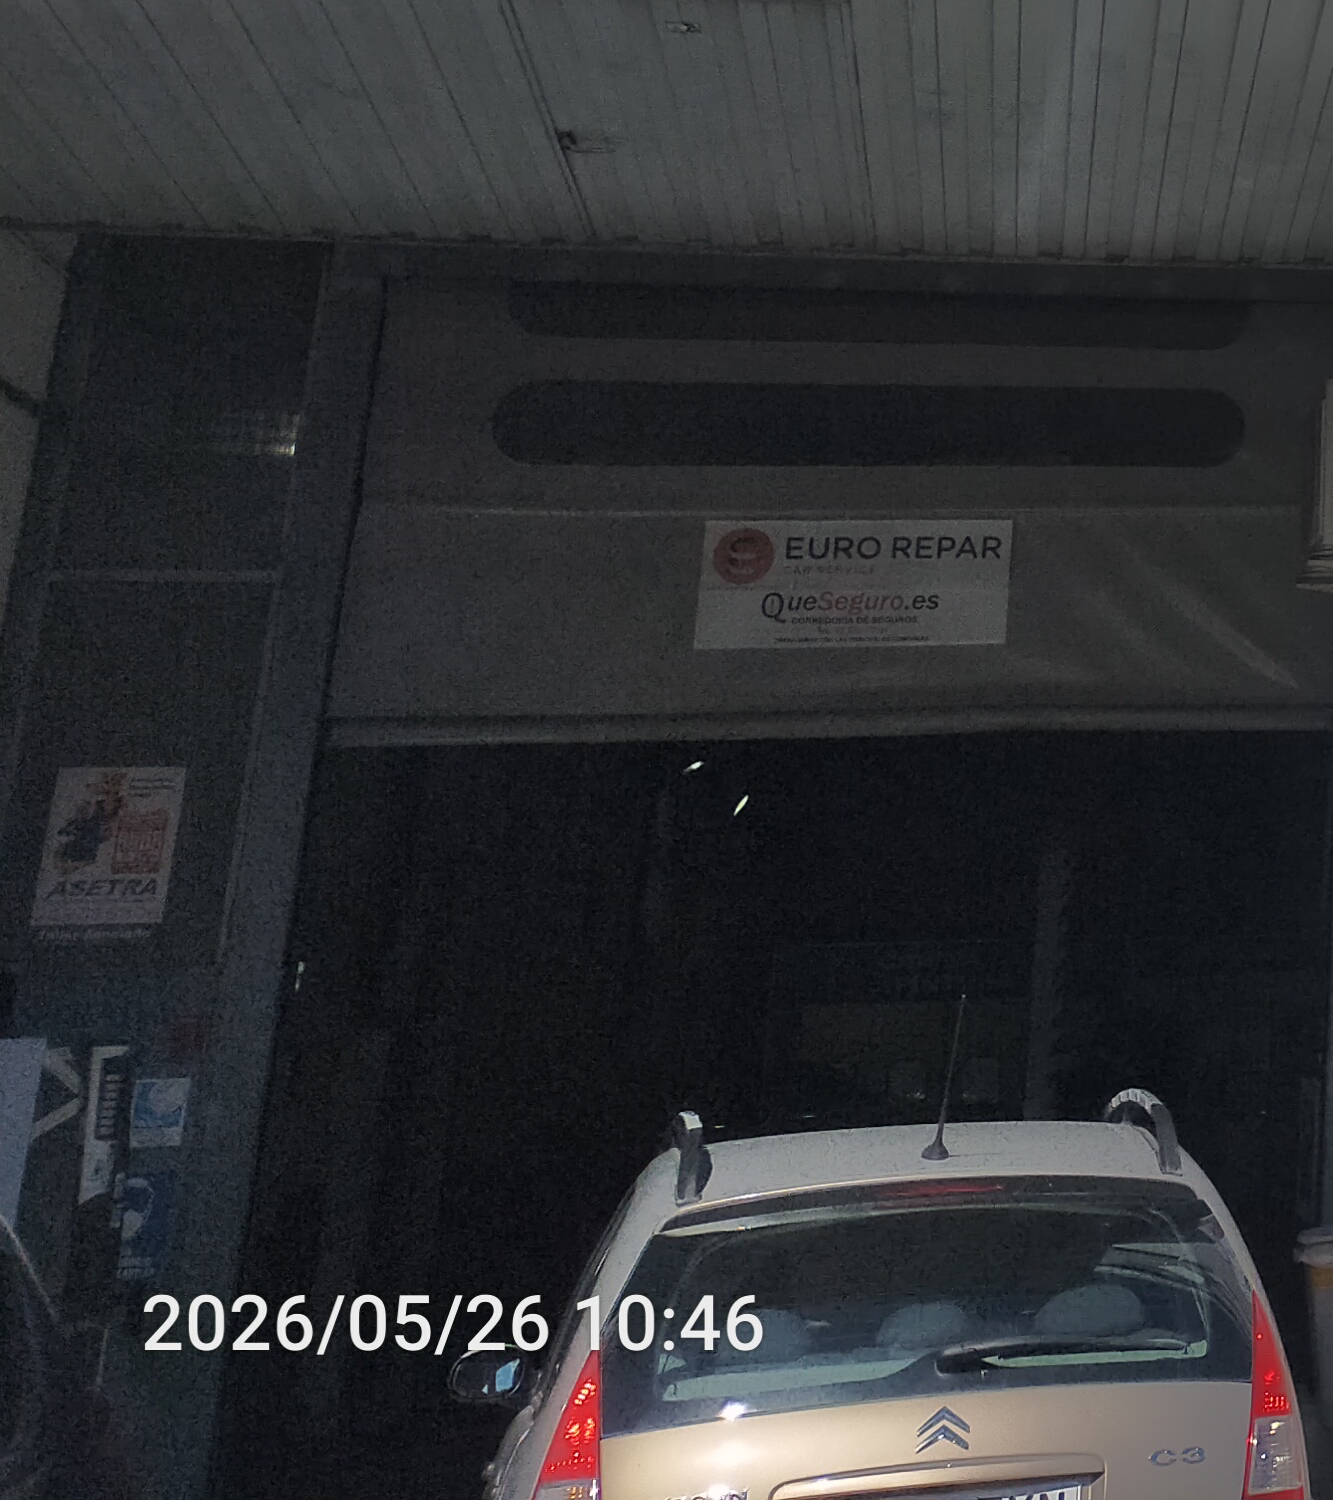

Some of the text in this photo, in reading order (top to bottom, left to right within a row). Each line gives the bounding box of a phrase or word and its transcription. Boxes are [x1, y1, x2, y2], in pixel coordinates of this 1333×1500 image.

[785, 536, 1001, 559] EURO REPAR
[1150, 1447, 1205, 1466] C3
